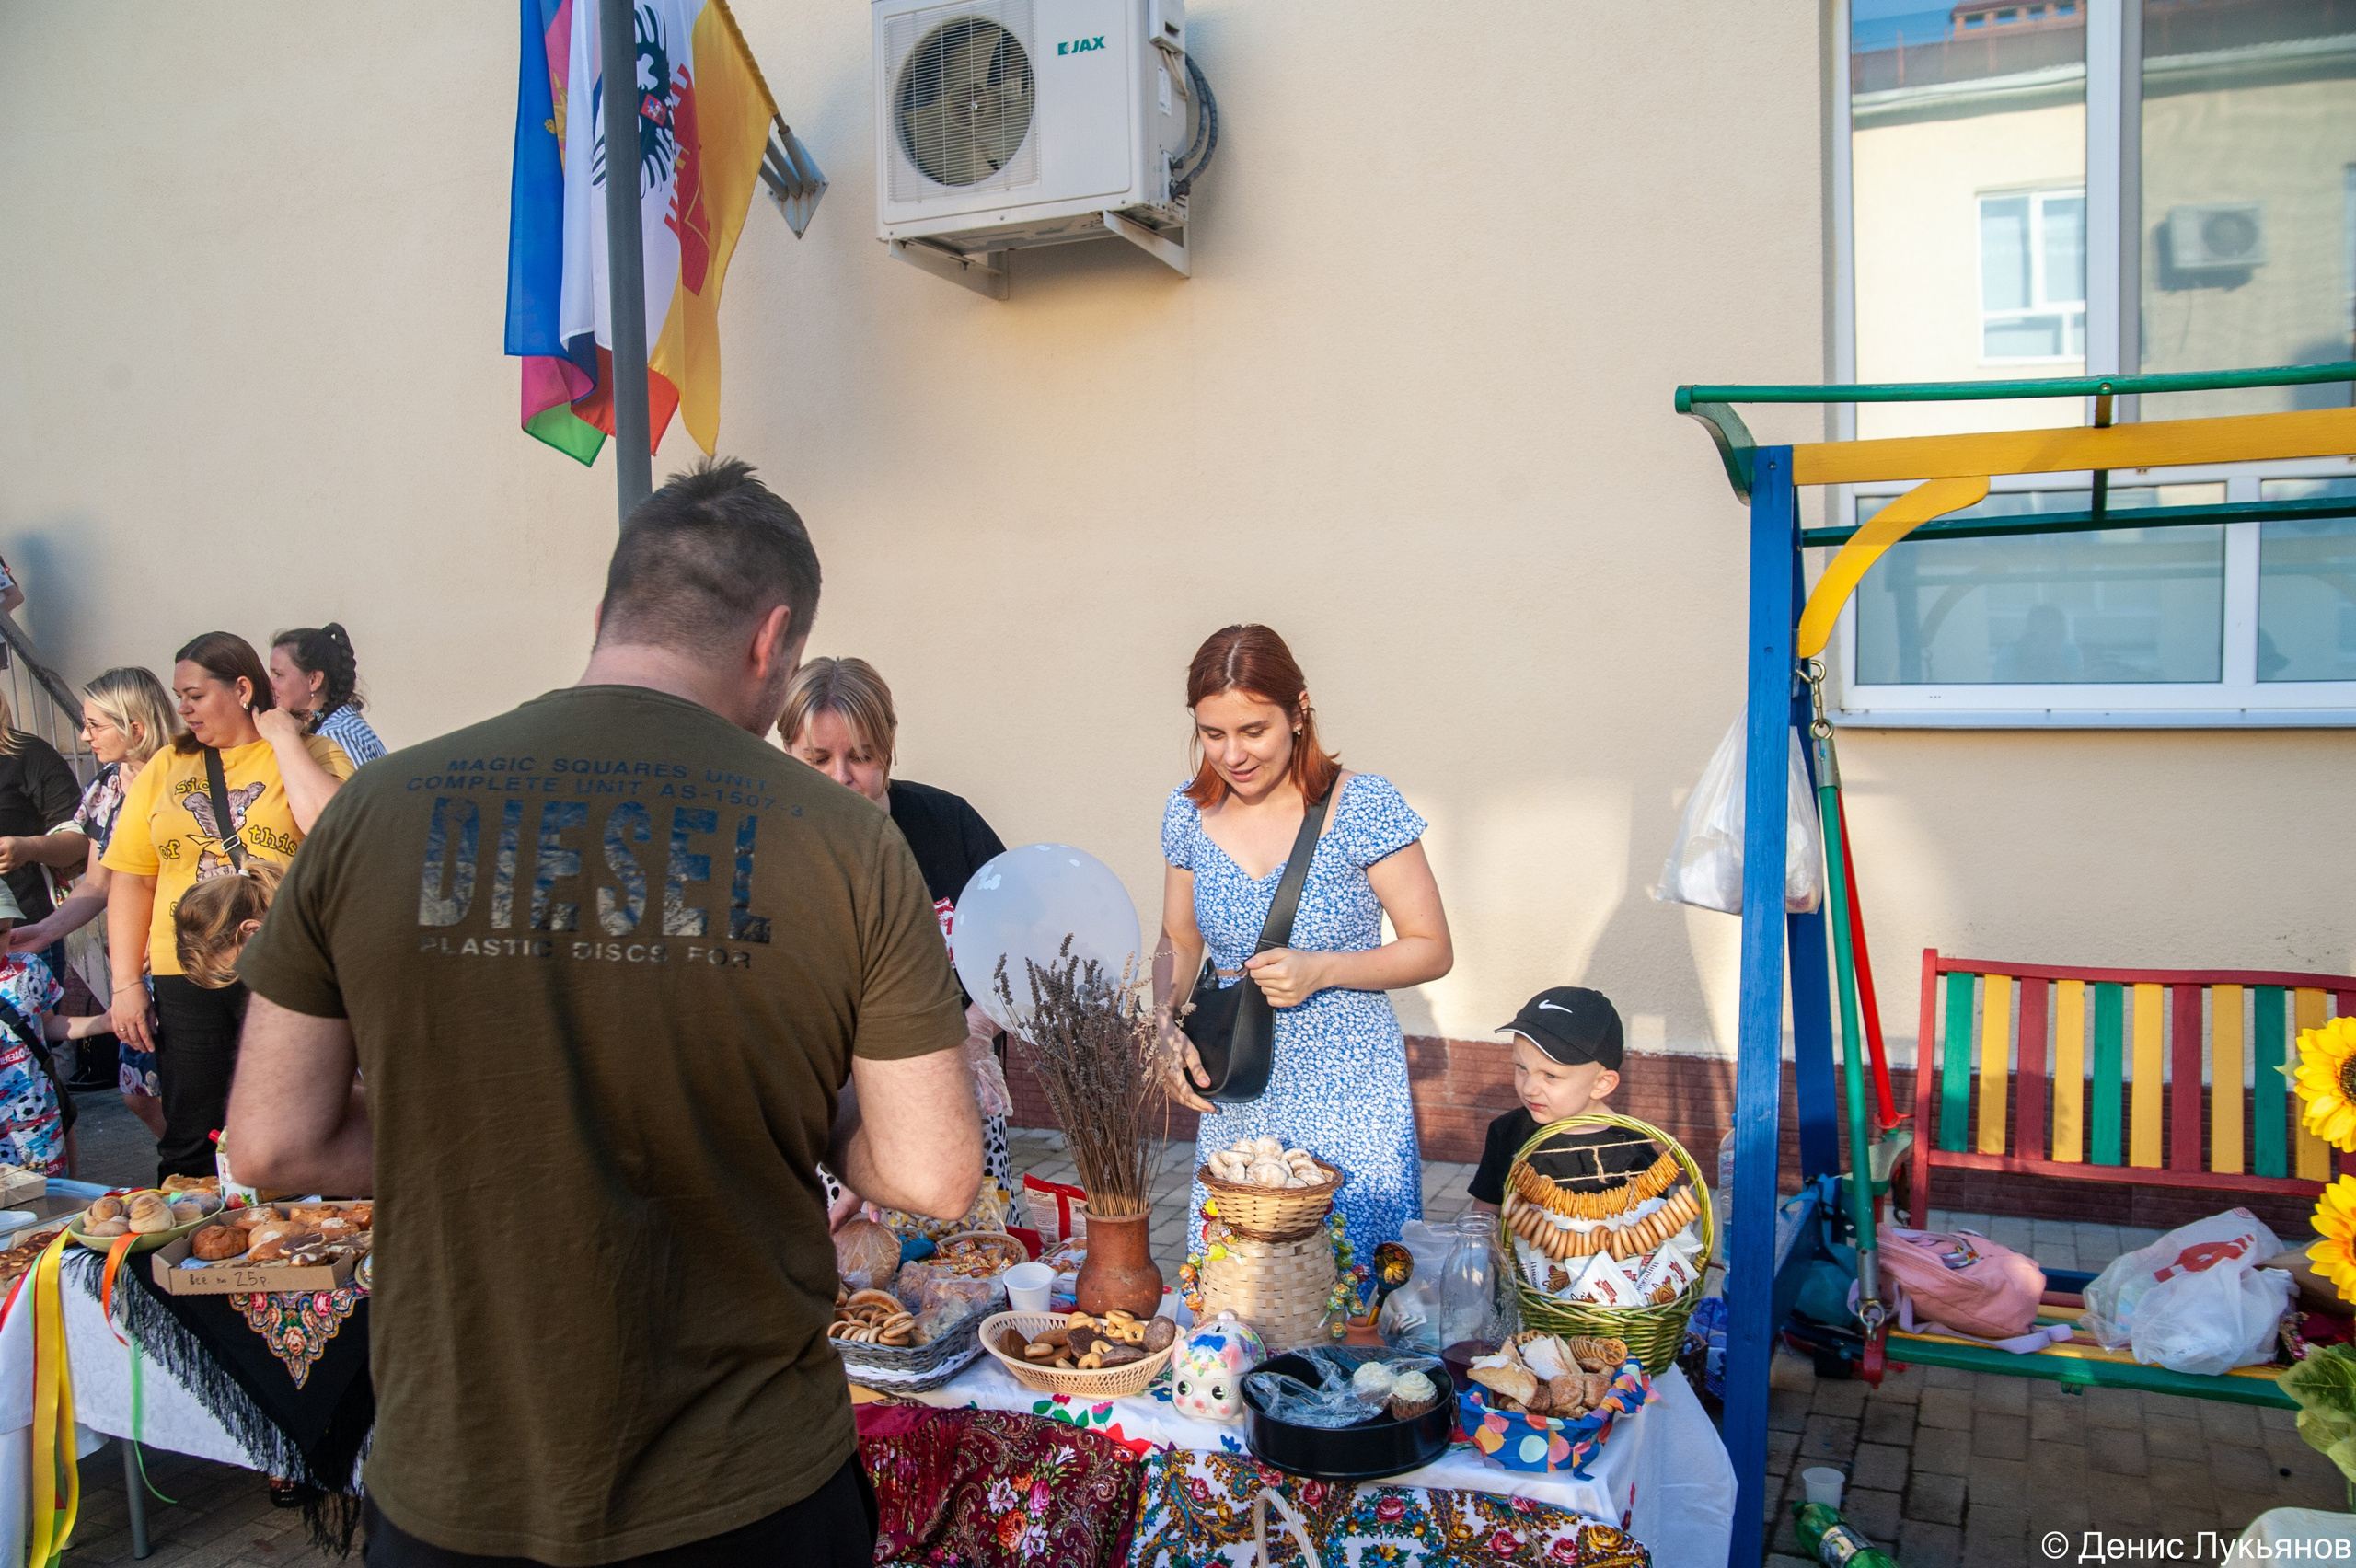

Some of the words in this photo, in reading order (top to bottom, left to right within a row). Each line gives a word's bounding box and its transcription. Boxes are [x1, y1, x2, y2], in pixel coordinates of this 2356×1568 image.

[1070, 36, 1106, 54] JAX
[174, 777, 211, 795] sic
[446, 756, 536, 773] MAGIC
[553, 757, 688, 779] SQUARES
[705, 768, 770, 791] UNIT
[406, 775, 558, 792] COMPLETE
[575, 778, 644, 795] UNIT
[658, 782, 803, 818] AS-1507-3
[158, 839, 180, 859] of
[248, 824, 298, 857] this
[417, 795, 772, 944] DIESEL
[417, 936, 553, 958] PLASTIC
[572, 941, 669, 964] DISCS
[687, 946, 751, 969] FOR
